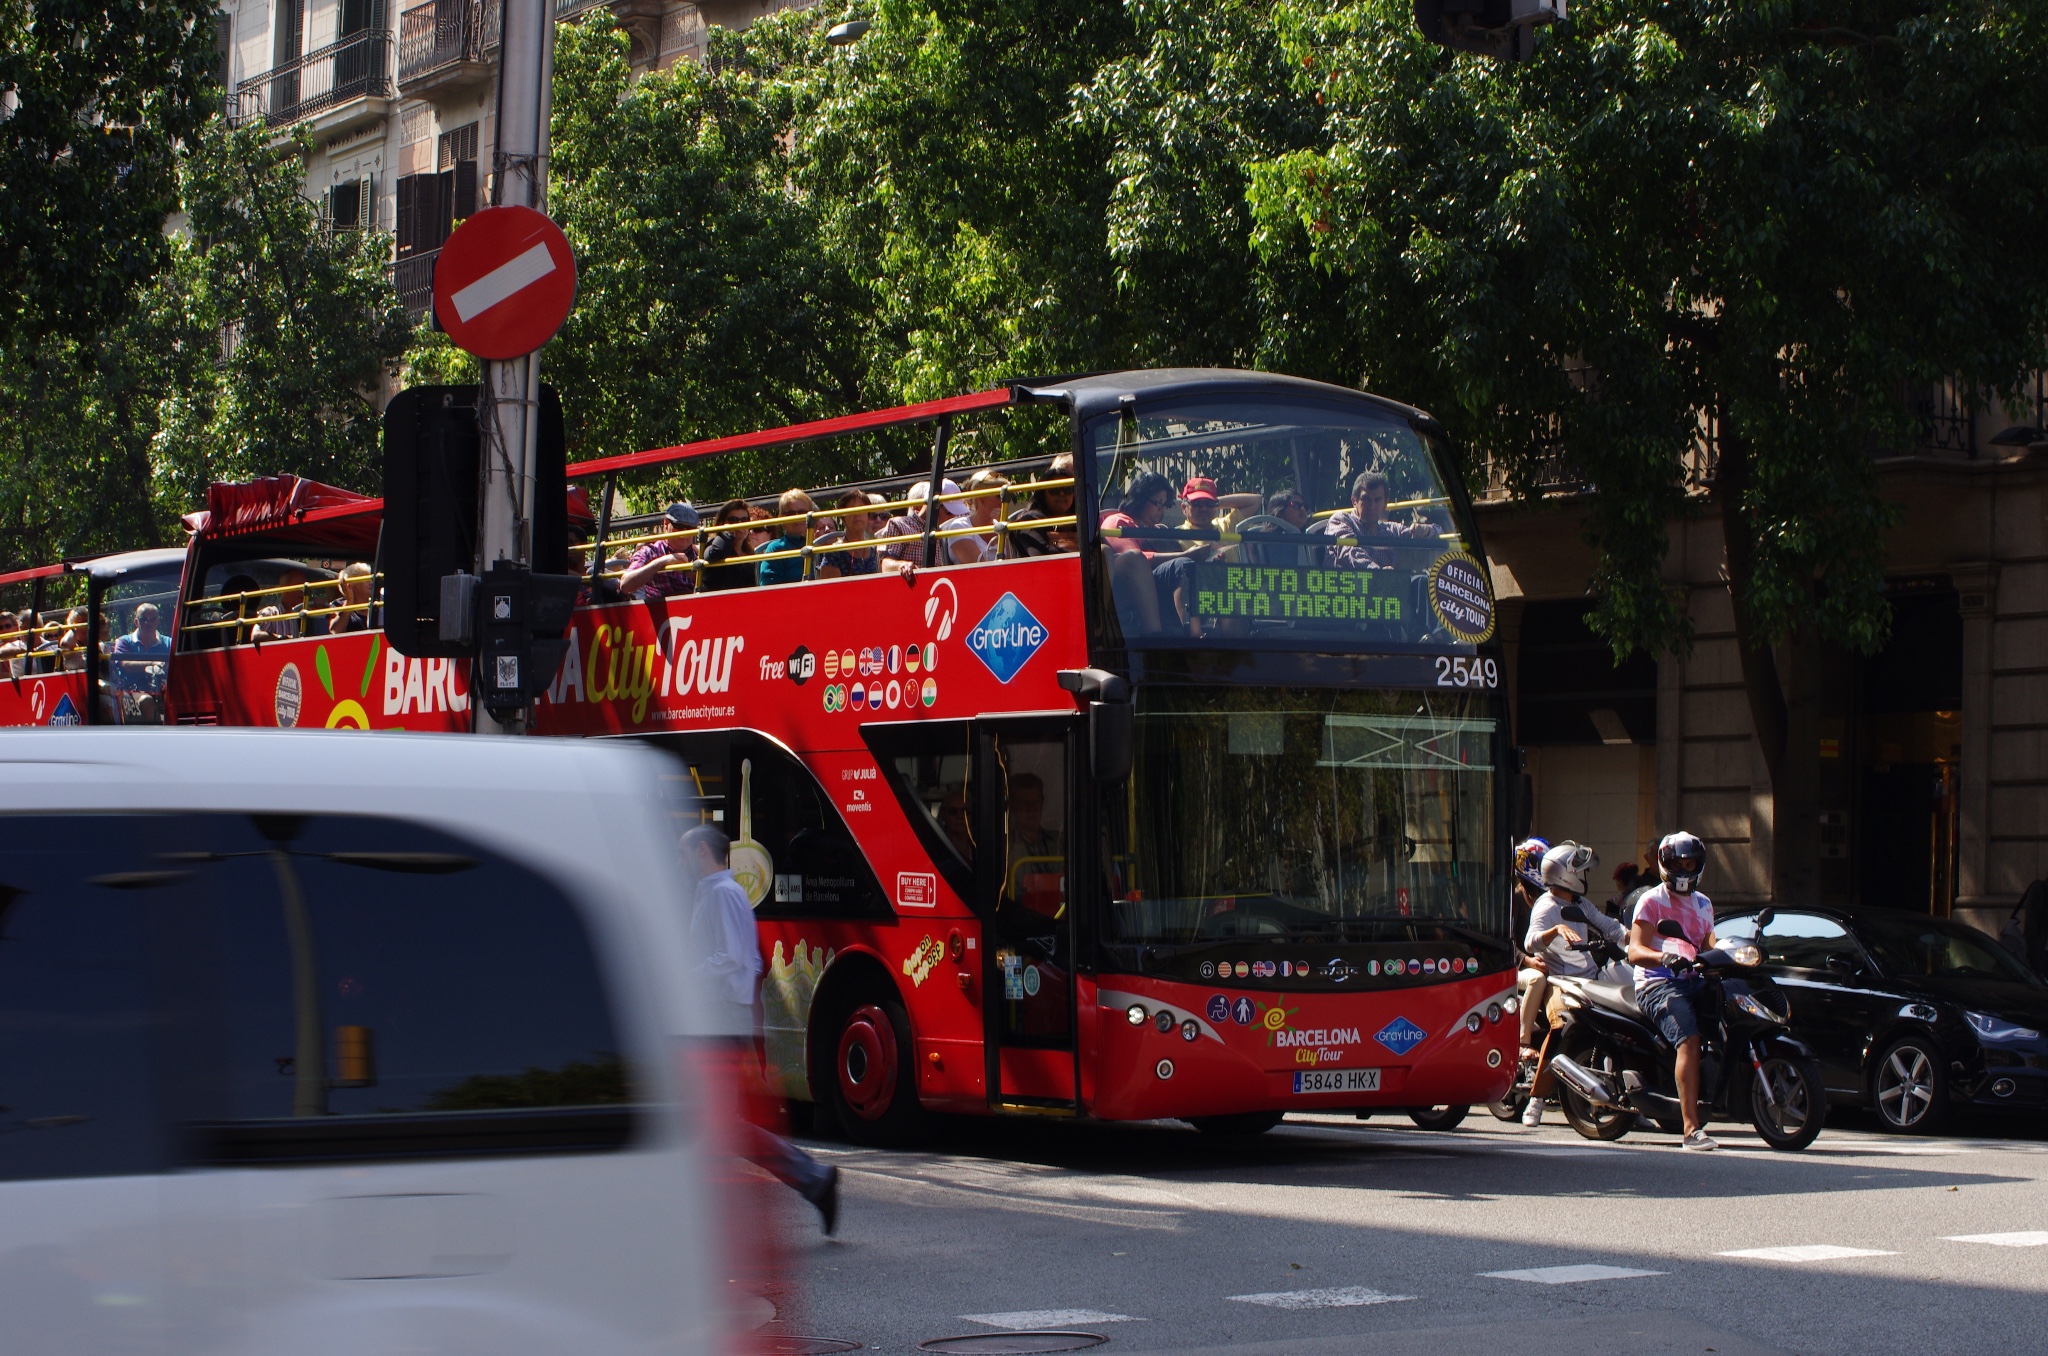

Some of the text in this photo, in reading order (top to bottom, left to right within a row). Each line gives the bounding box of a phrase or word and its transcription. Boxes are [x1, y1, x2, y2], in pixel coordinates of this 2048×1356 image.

[1227, 567, 1373, 594] RUTA OEST
[1447, 564, 1485, 593] OFFICIAL
[1198, 591, 1401, 620] RUTA TARONJA
[1438, 577, 1491, 613] BARCELONA
[1440, 600, 1486, 630] city TOUR
[760, 655, 785, 681] Free
[1435, 656, 1498, 688] 2549
[651, 704, 736, 722] www.barcelonacitytour.es
[846, 801, 872, 812] moventis
[901, 877, 927, 887] BUY HERE
[814, 892, 840, 902] Barcelona
[1276, 1027, 1361, 1047] BARCELONA
[1304, 1072, 1343, 1090] 5848
[1348, 1071, 1377, 1089] HKX
